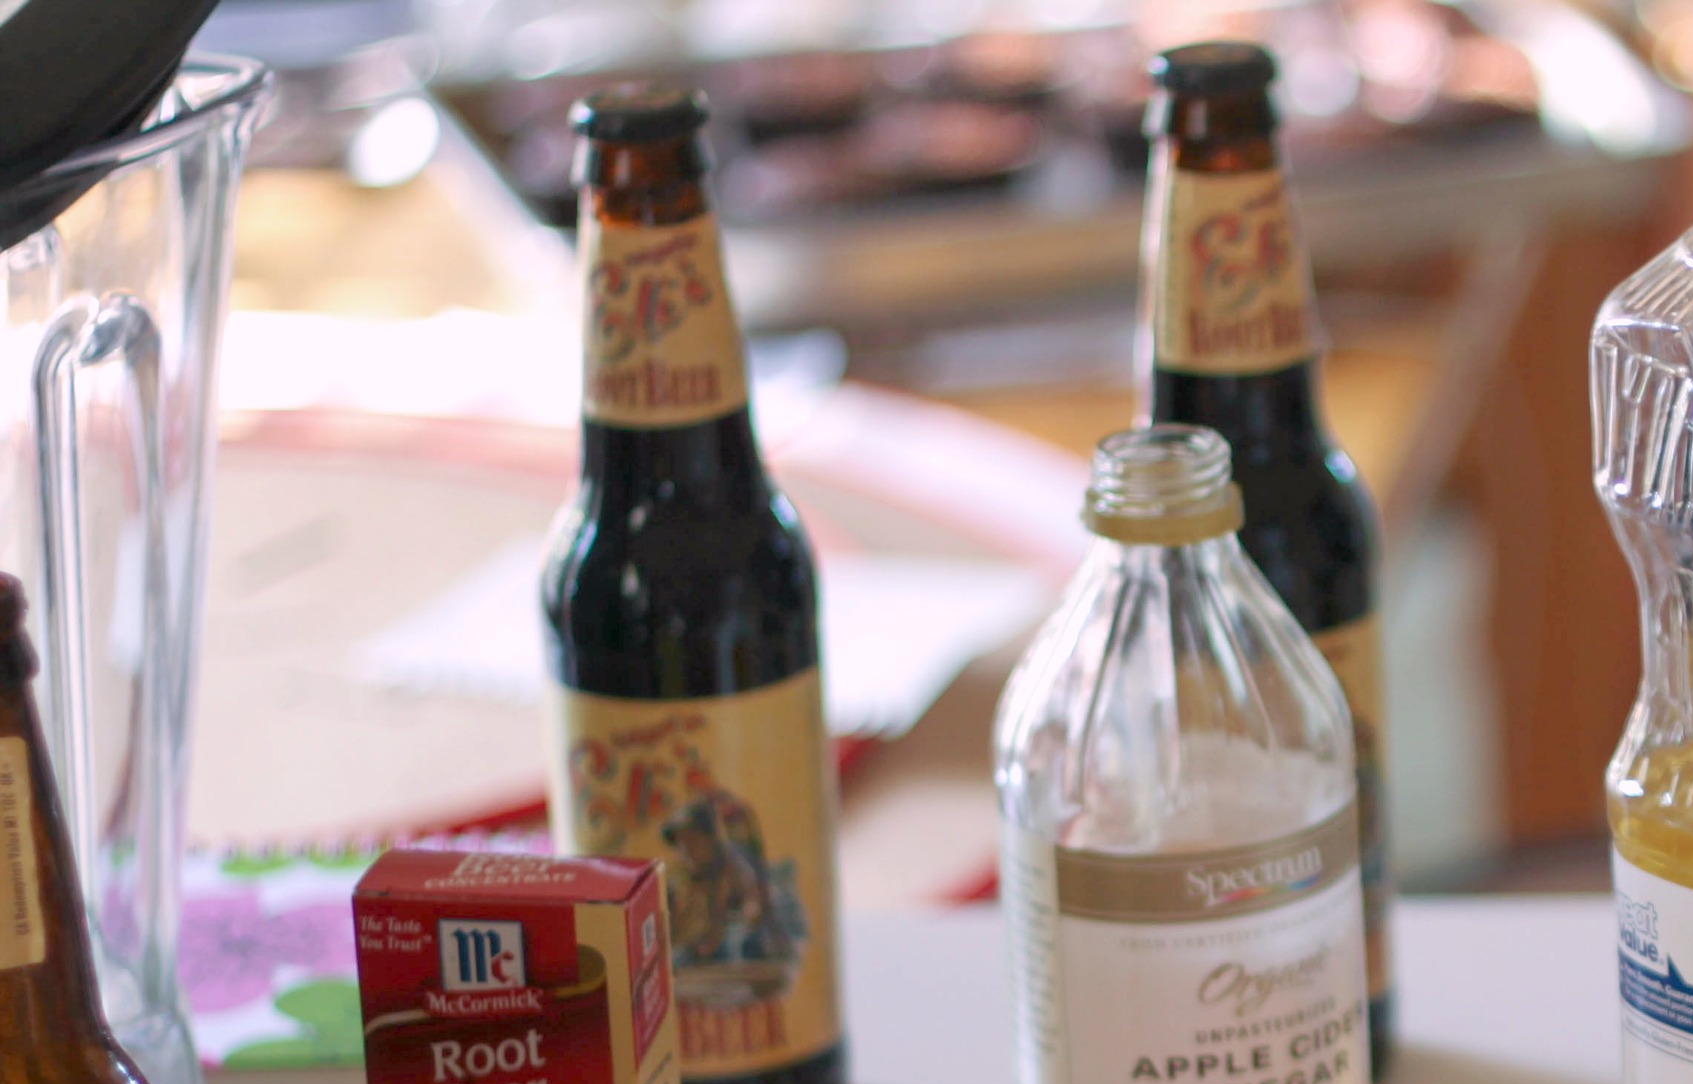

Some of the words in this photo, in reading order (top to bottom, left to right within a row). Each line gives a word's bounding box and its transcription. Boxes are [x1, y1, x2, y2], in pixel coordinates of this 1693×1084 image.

[1185, 846, 1324, 909] Spectrum
[425, 989, 541, 1013] McCormick
[430, 1029, 546, 1082] Root
[1130, 1044, 1273, 1081] APPLE
